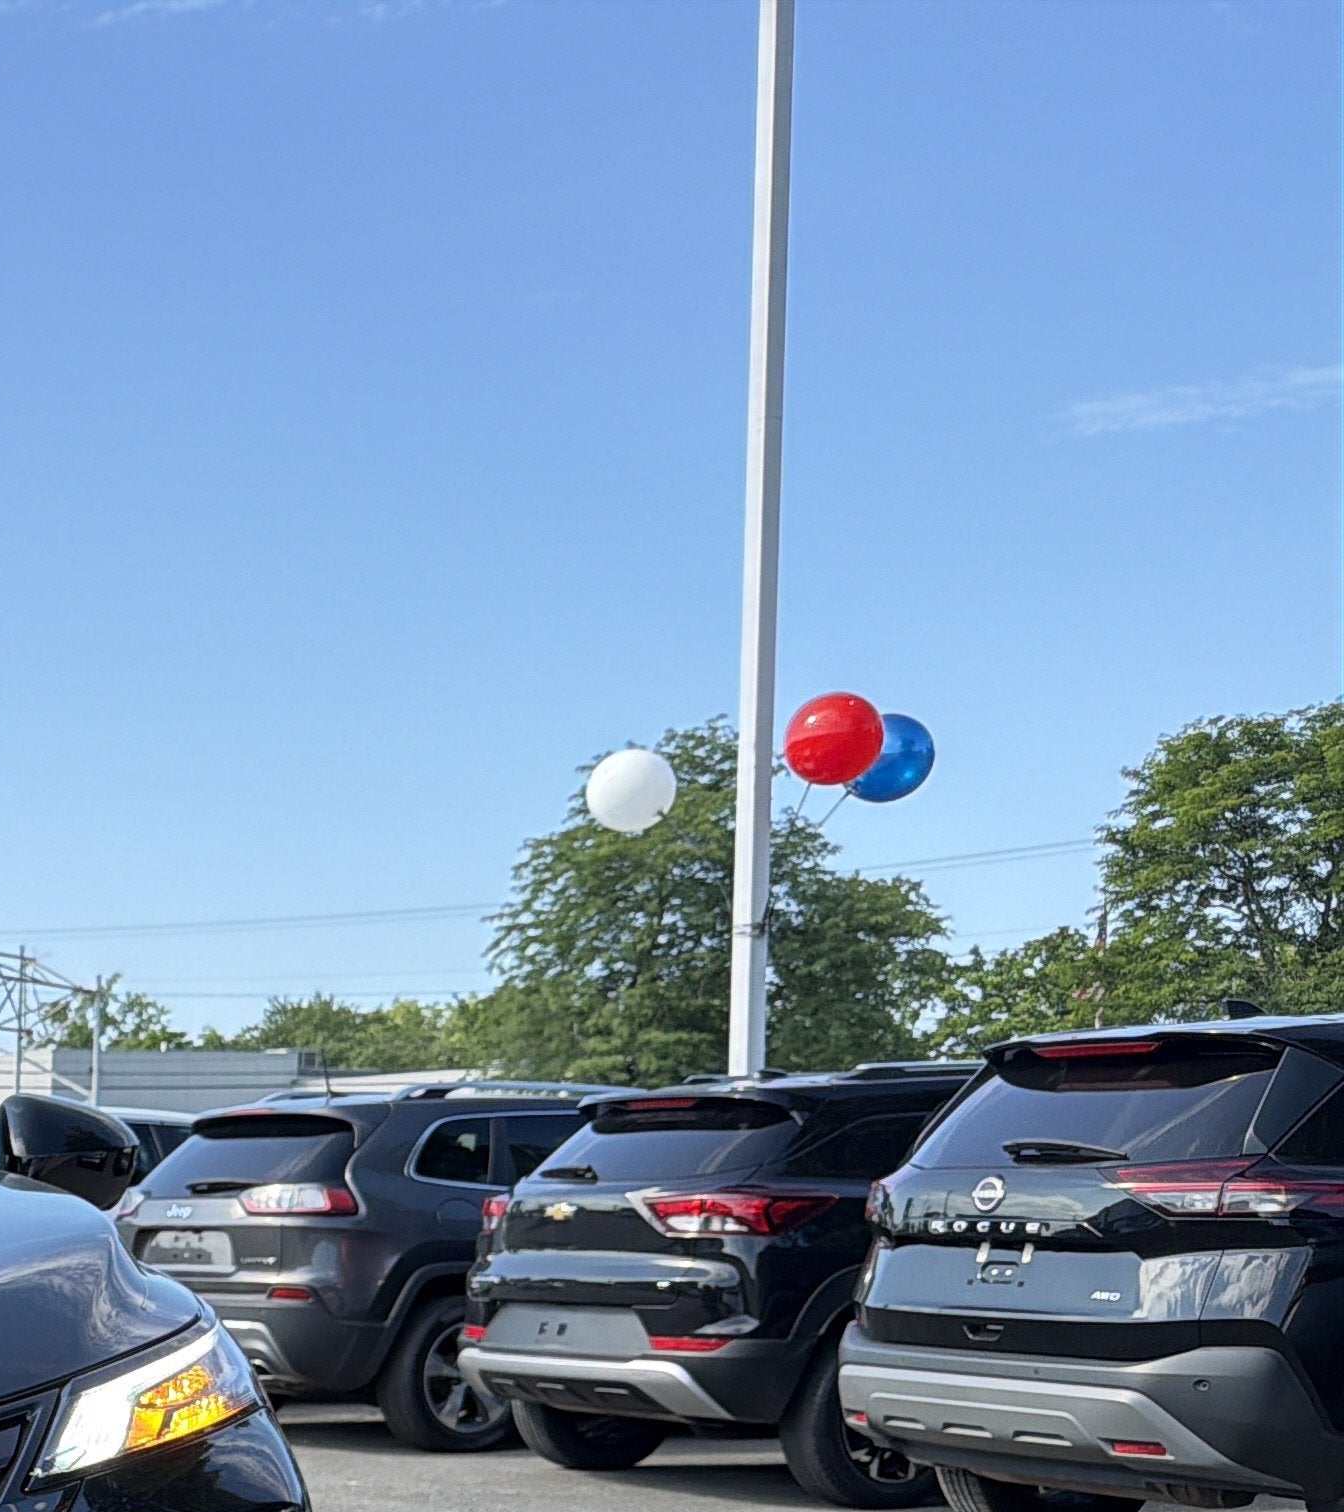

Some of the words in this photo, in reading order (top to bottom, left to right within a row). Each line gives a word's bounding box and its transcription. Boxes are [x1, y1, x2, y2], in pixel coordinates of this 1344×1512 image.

[166, 1204, 193, 1219] Jeep
[930, 1220, 1041, 1234] ROGUE
[1091, 1290, 1122, 1301] AWD
